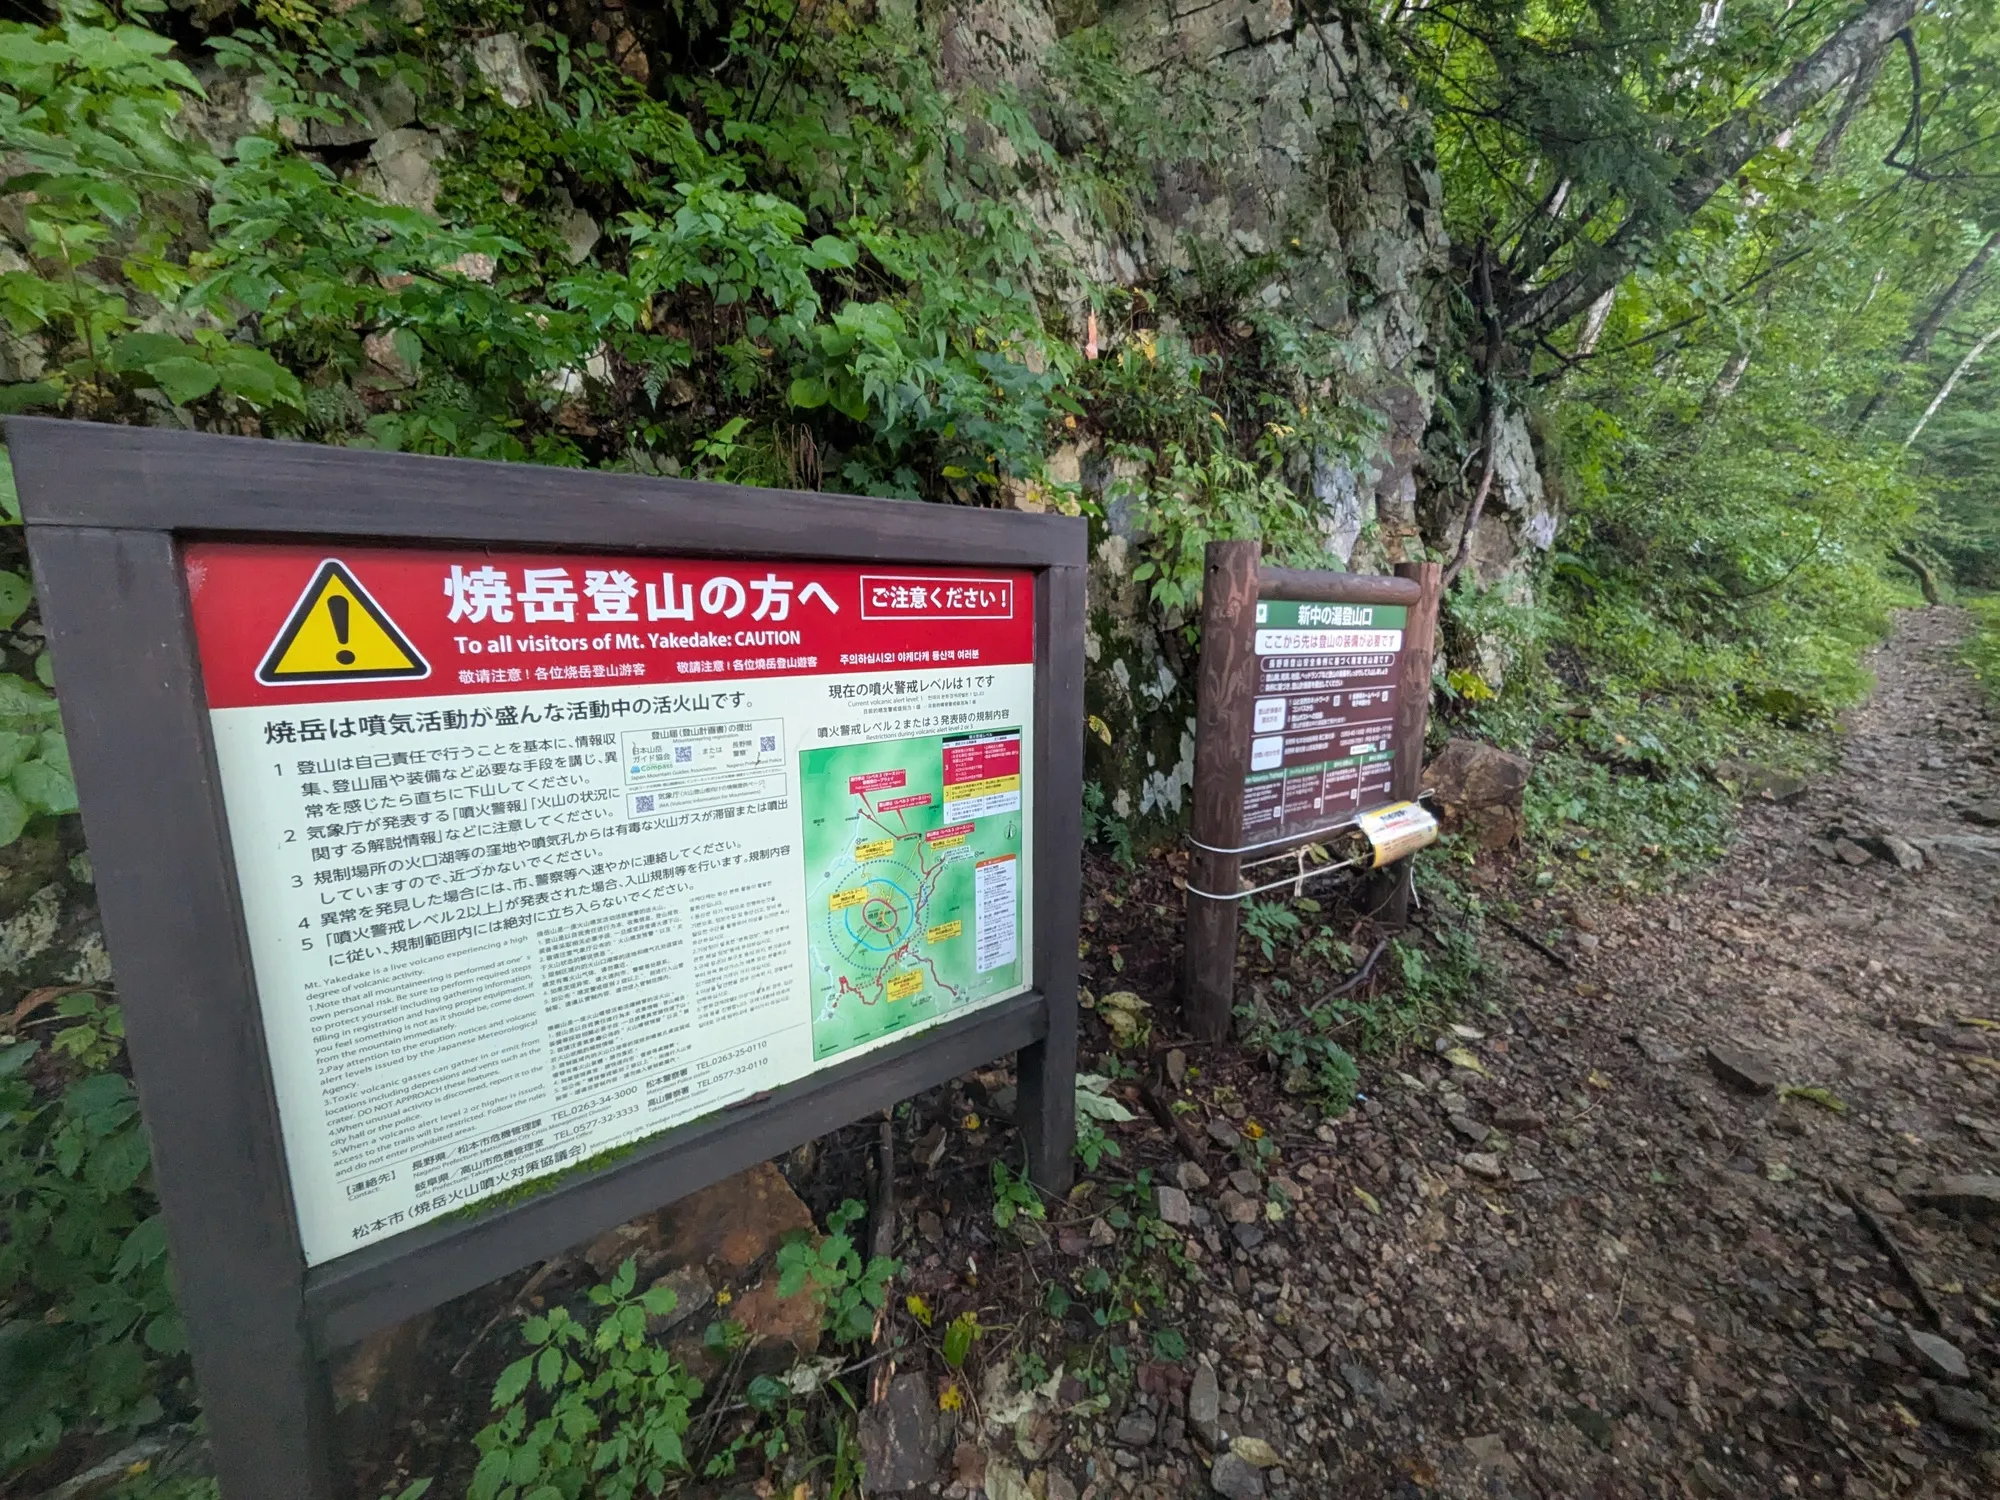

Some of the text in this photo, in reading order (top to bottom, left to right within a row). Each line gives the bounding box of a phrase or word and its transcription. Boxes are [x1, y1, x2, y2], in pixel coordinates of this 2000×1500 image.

[443, 564, 839, 623] 焼岳登山の方へ
[872, 585, 1006, 608] ご注意ください！
[1298, 604, 1373, 626] 新中の湯登山口
[453, 630, 800, 654] To all visitors of Mt. Yakedake: CAUTION
[839, 649, 979, 665] 주의하십시오! 야케다케 등산객 여러분
[1265, 634, 1395, 649] ここから先は登山の装備が必要です
[458, 662, 645, 684] 敬请注意！各位烧岳登山游客
[828, 674, 995, 699] 現在の噴火警戒レベルは1です
[263, 691, 752, 744] 焼岳は噴気活動が盛んな活動中の活火山です。
[817, 708, 1009, 738] 噴火警戒レベル2または3発表時の規制内容
[296, 732, 616, 775] 登山は自己責任で行うことを基本に、情報収
[300, 750, 617, 797] 集、登山届や装備など必要な手段を講じ、異
[639, 761, 673, 772] Compass
[283, 788, 620, 842] 2 気象庁が発表する「噴火警報」「火山の状況に
[304, 775, 589, 818] 常を感じたら直ちに下山してください。
[290, 798, 787, 888] 3 規制場所の火口湖等の窪地や噴気孔からは有毒な火山ガスが滞留または噴出
[311, 808, 613, 862] 関する解説情報」などに注意してください。
[298, 840, 741, 929] 4 異常を発見した場合には、市、警察等へ速やかに連絡してください。
[301, 937, 313, 951] 5
[325, 844, 790, 947] 「噴火警戒レベル2以上」が発表された場合、入山規制等を行います。規制内容
[320, 848, 603, 904] していますので、近づかないでください。
[329, 882, 693, 966] に従い、規制範囲内には絶対に立ち入らないでください。
[695, 1040, 767, 1070] TEL.0263-25-0110
[696, 1057, 768, 1088] TEL.0577-32-0110
[412, 1118, 542, 1171] 長野県／松本市危機管理課
[550, 1085, 638, 1121] TEL.0263-34-3000
[414, 1138, 543, 1192] 岐阜県／高山市危機管理室
[553, 1104, 639, 1140] TEL.0577-32-3333
[346, 1169, 396, 1195] 【連絡先】
[351, 1142, 586, 1239] 松本市（焼岳火山噴火対策協議会）
